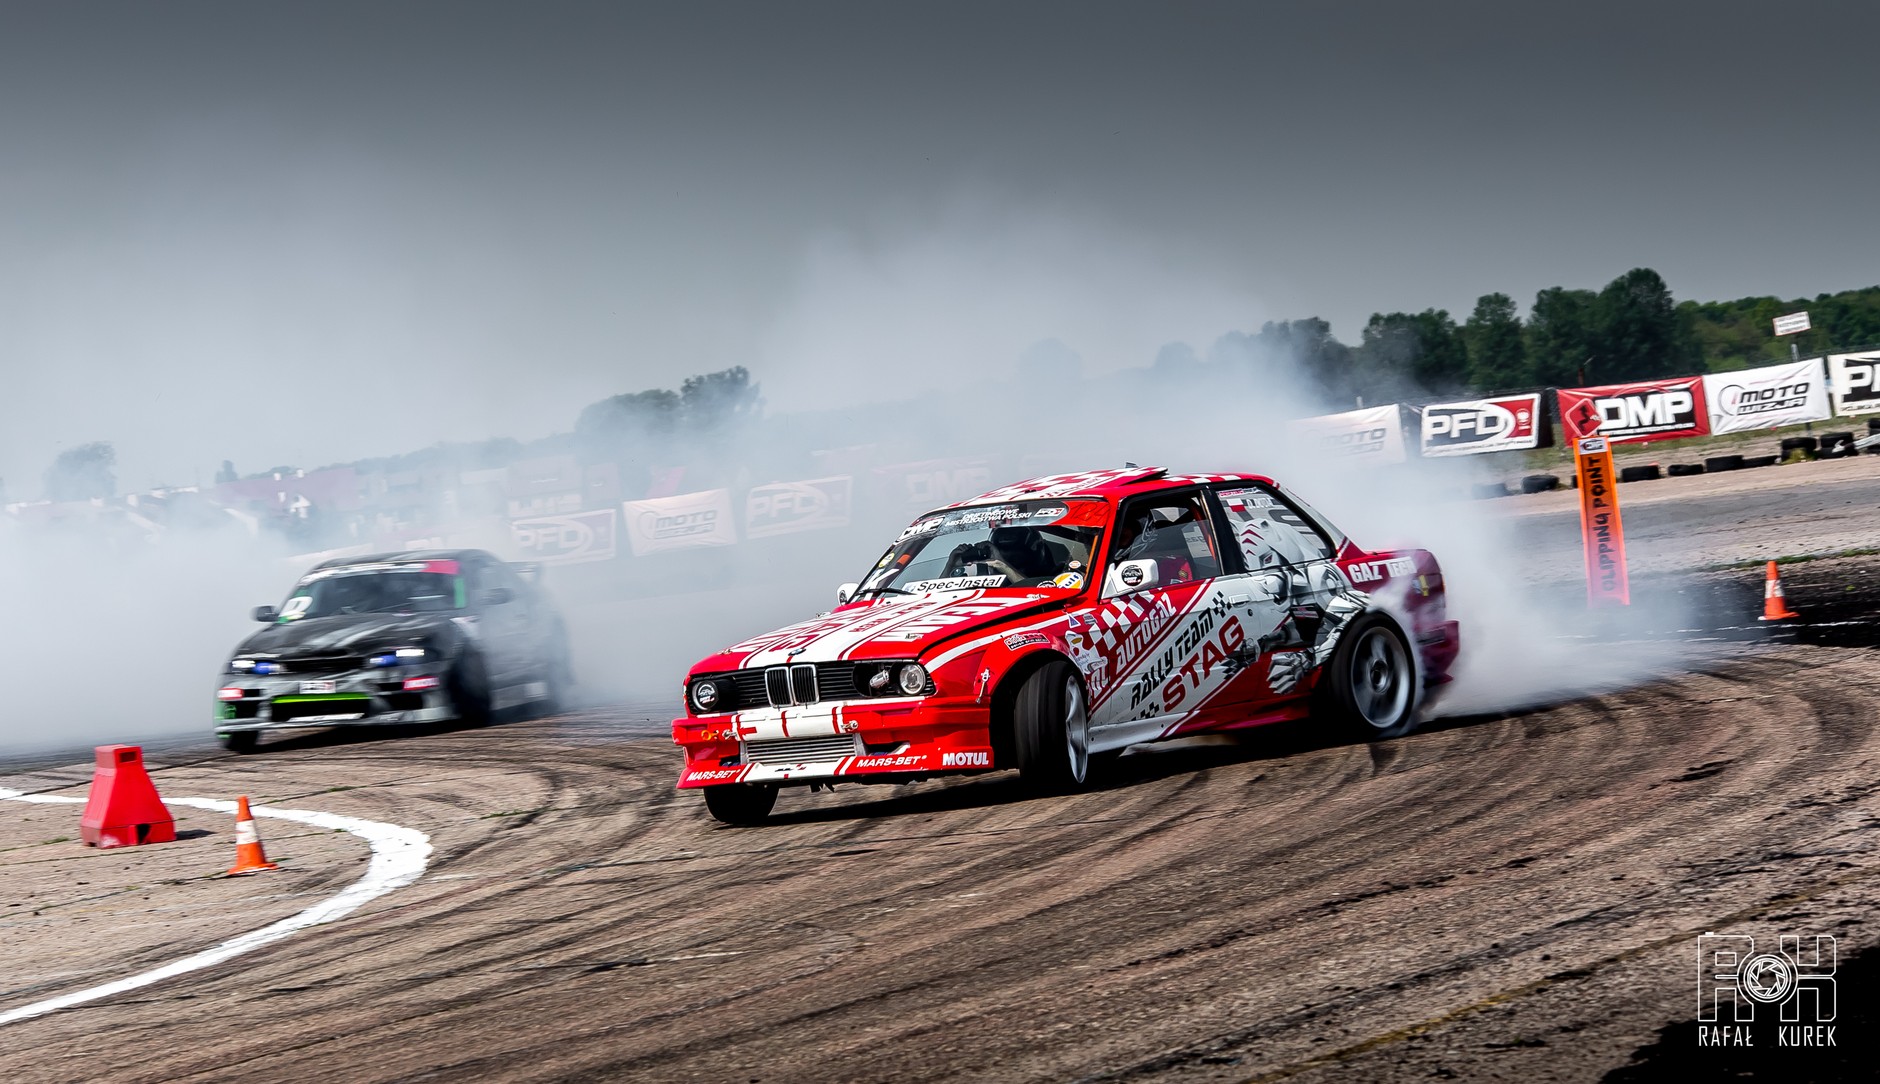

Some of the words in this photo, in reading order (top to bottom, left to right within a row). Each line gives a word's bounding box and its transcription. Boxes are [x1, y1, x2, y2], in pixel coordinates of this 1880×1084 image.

[1845, 363, 1880, 394] P
[1740, 382, 1810, 403] MOTO
[1595, 391, 1693, 429] DMP
[1737, 396, 1807, 415] WIZJA
[1423, 411, 1506, 440] PFD
[1587, 456, 1608, 508] POINT
[655, 510, 718, 529] MOTO
[1003, 511, 1032, 520] POLSKI
[515, 526, 585, 551] PFD
[916, 576, 1001, 593] Spec-Instal
[1347, 561, 1384, 583] GAZ
[1116, 592, 1177, 675] AUTOGAZ
[1131, 646, 1174, 710] RALLY
[1174, 607, 1214, 662] TEAM
[1162, 615, 1245, 713] STAG
[942, 751, 989, 766] MOTUL
